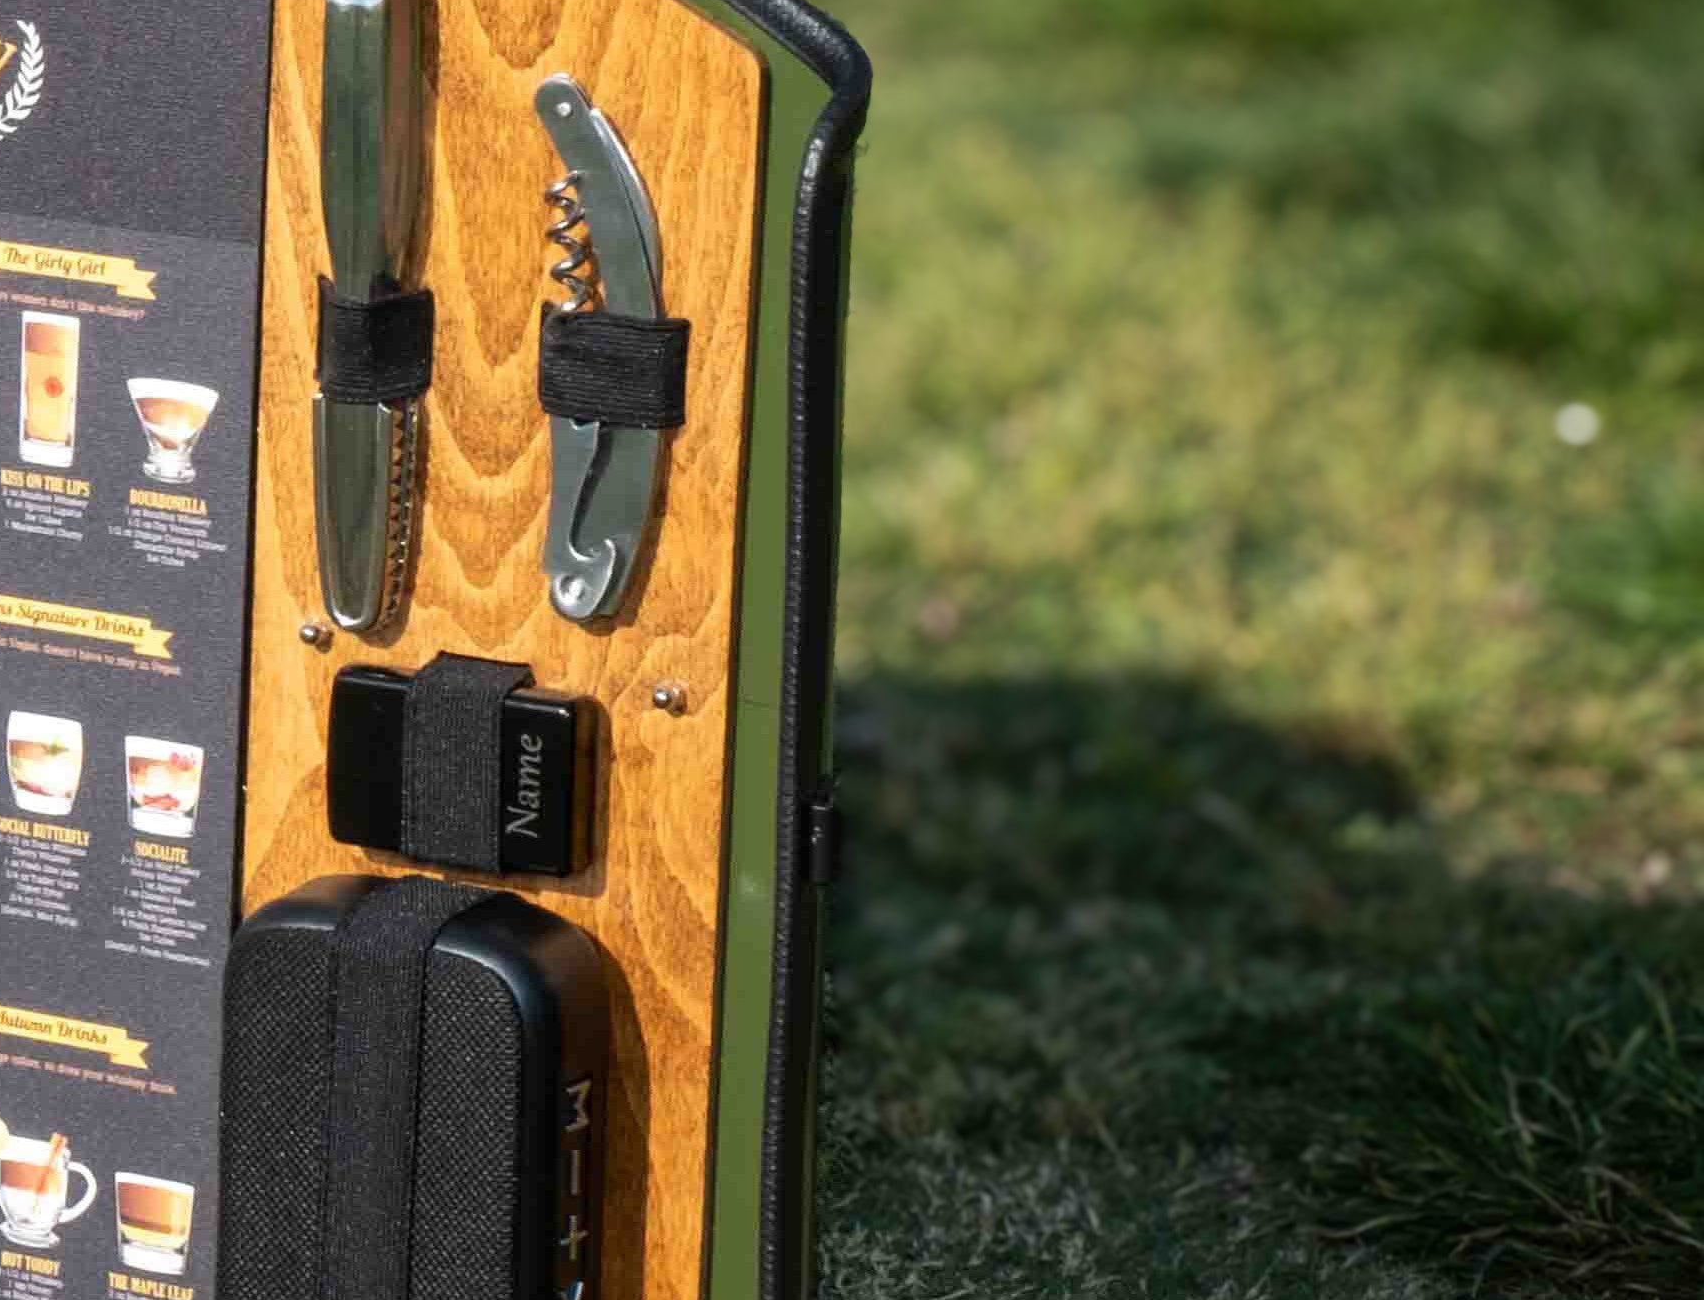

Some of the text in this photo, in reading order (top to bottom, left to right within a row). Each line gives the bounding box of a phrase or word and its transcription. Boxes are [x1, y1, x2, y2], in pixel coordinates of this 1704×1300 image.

[4, 247, 106, 276] The Girly Girl
[16, 603, 88, 628] Signature
[93, 616, 146, 637] Drinks
[504, 733, 544, 838] Name
[56, 1020, 109, 1045] Drinks
